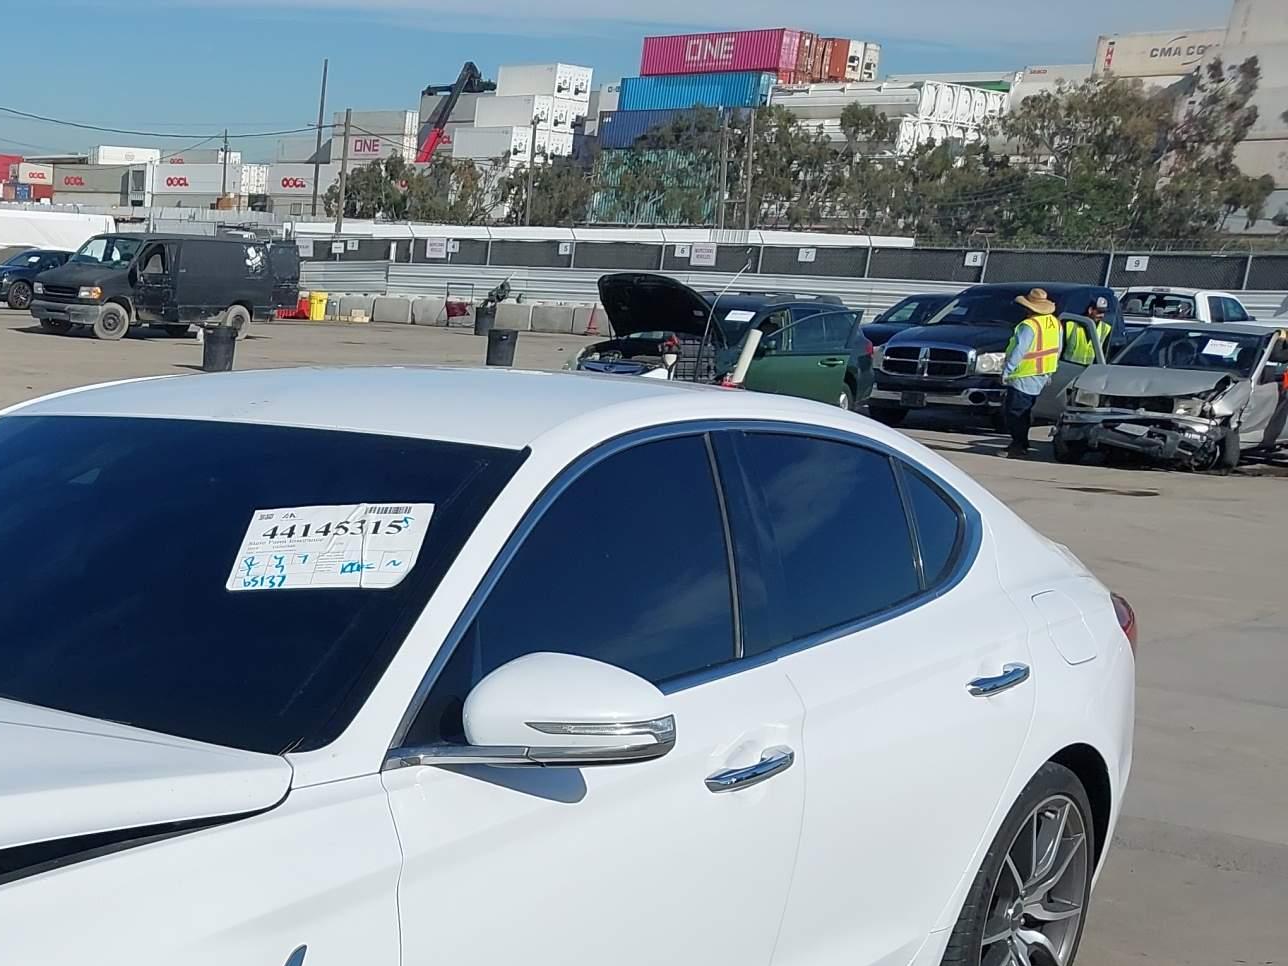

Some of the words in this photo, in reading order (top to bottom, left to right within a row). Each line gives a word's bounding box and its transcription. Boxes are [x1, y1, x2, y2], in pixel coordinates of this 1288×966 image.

[685, 37, 734, 61] ONE
[1150, 47, 1181, 58] CMA
[353, 139, 380, 152] ONE
[64, 176, 85, 186] OOCL
[166, 177, 189, 187] OOCL
[262, 519, 403, 539] 44145315
